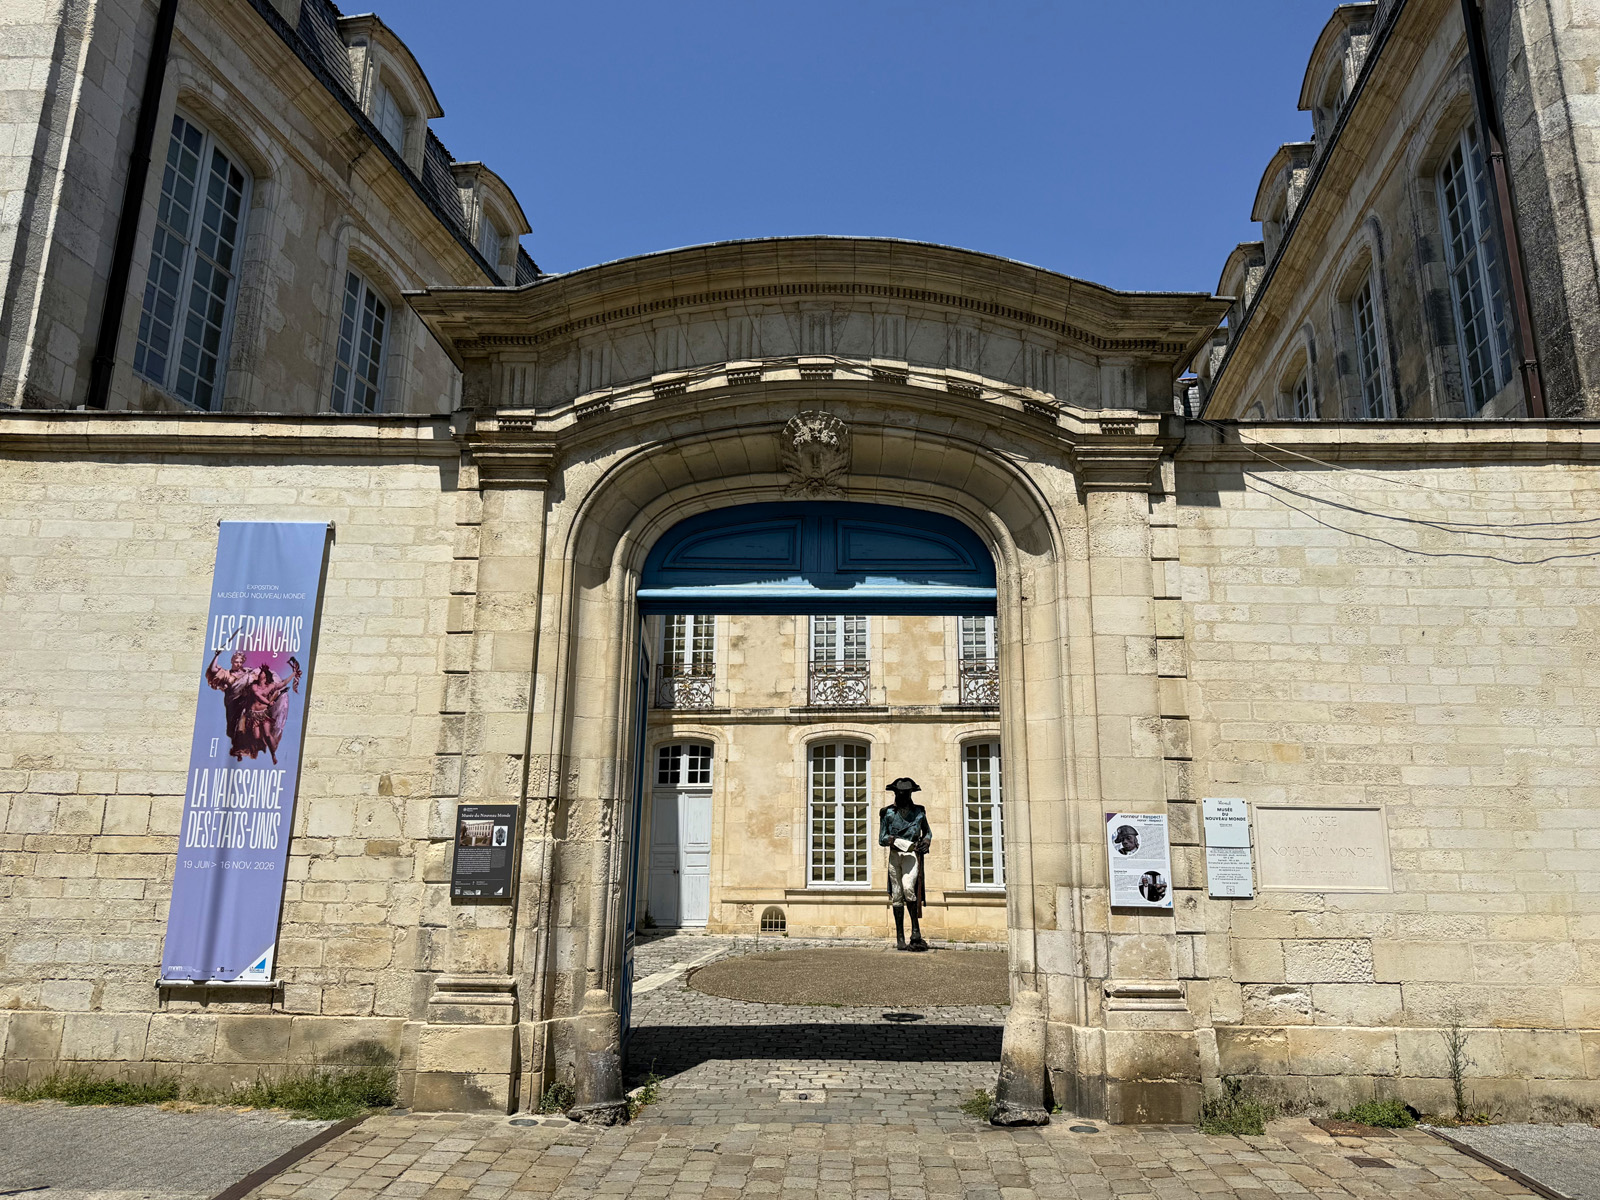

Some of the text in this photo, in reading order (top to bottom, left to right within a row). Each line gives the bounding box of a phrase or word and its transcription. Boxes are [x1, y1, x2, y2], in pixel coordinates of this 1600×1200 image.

[217, 591, 239, 599] MUSÉE
[250, 592, 282, 600] NOUVEAU
[211, 614, 304, 658] LES FRANÇAIS
[209, 737, 220, 758] ET
[190, 768, 286, 810] LA NAISSANCE
[185, 808, 281, 850] DES ÉTATS-UNIS
[1312, 831, 1328, 842] DU
[1270, 846, 1374, 858] NOUVEAU MONDE
[183, 860, 192, 868] 19
[220, 861, 230, 869] 16
[232, 861, 252, 870] NOV.
[254, 862, 274, 870] 2026
